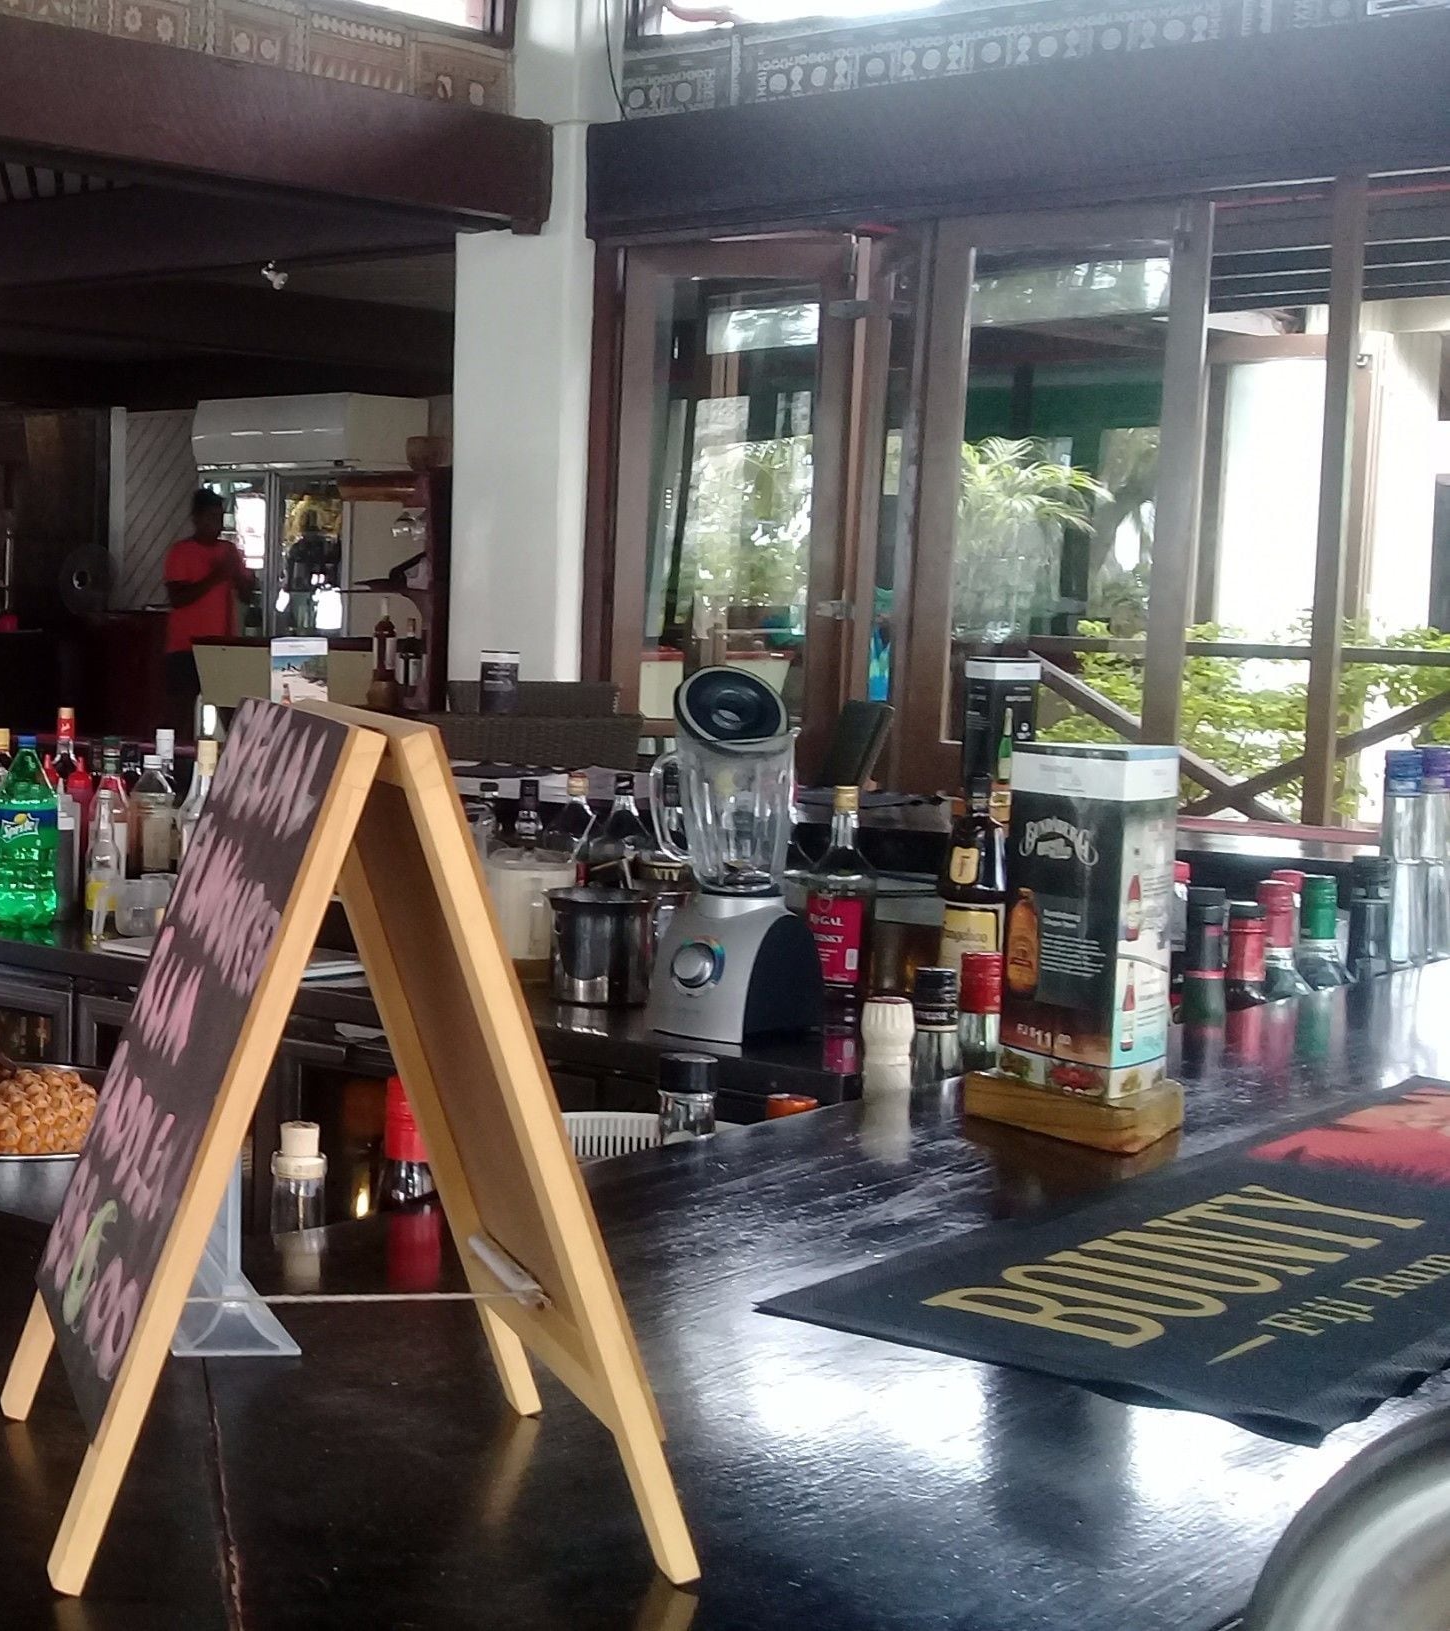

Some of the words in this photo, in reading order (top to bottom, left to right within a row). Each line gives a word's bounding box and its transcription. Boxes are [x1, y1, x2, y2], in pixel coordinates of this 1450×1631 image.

[211, 699, 328, 840] SPECIAL
[130, 925, 205, 1066] RUM
[922, 1184, 1427, 1349] BOUNTY
[1257, 1295, 1375, 1337] Fiji
[1341, 1253, 1450, 1299] Rum
